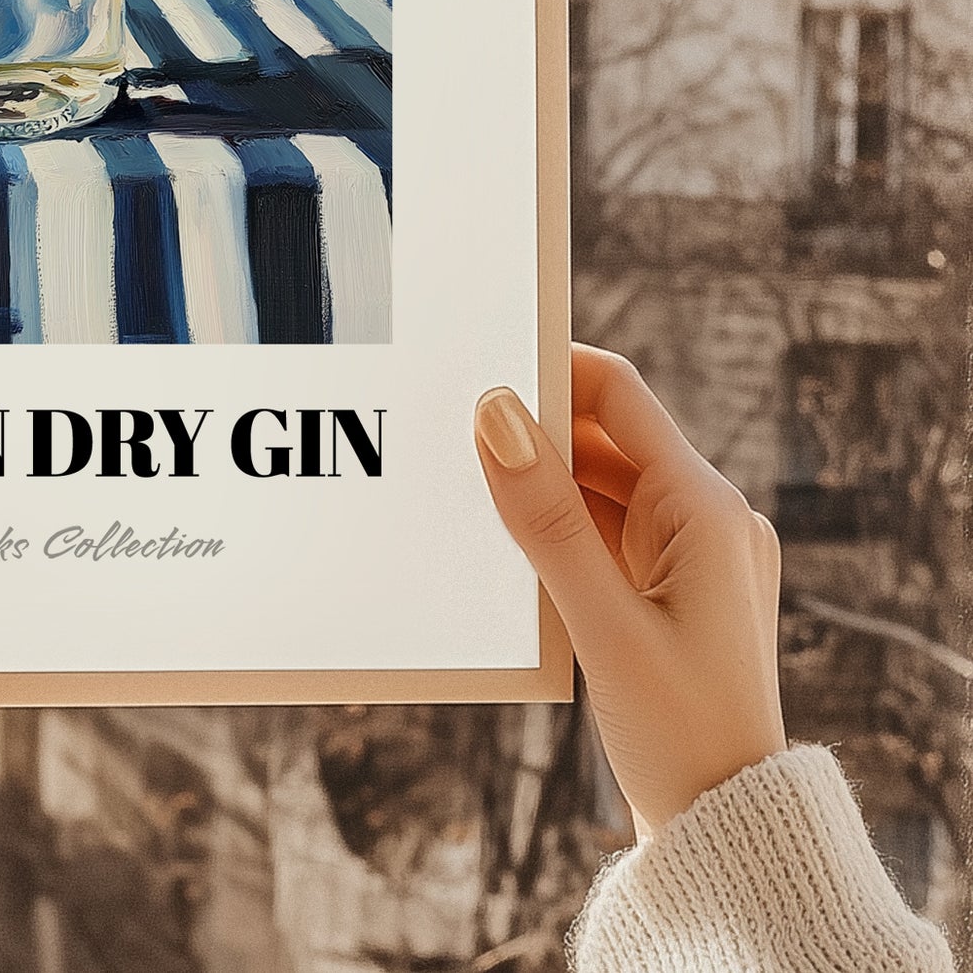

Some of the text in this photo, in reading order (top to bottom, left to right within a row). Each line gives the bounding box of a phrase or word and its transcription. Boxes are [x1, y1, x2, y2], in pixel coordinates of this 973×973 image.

[26, 409, 215, 479] DRY
[230, 409, 388, 478] GIN
[43, 520, 226, 562] Collection
